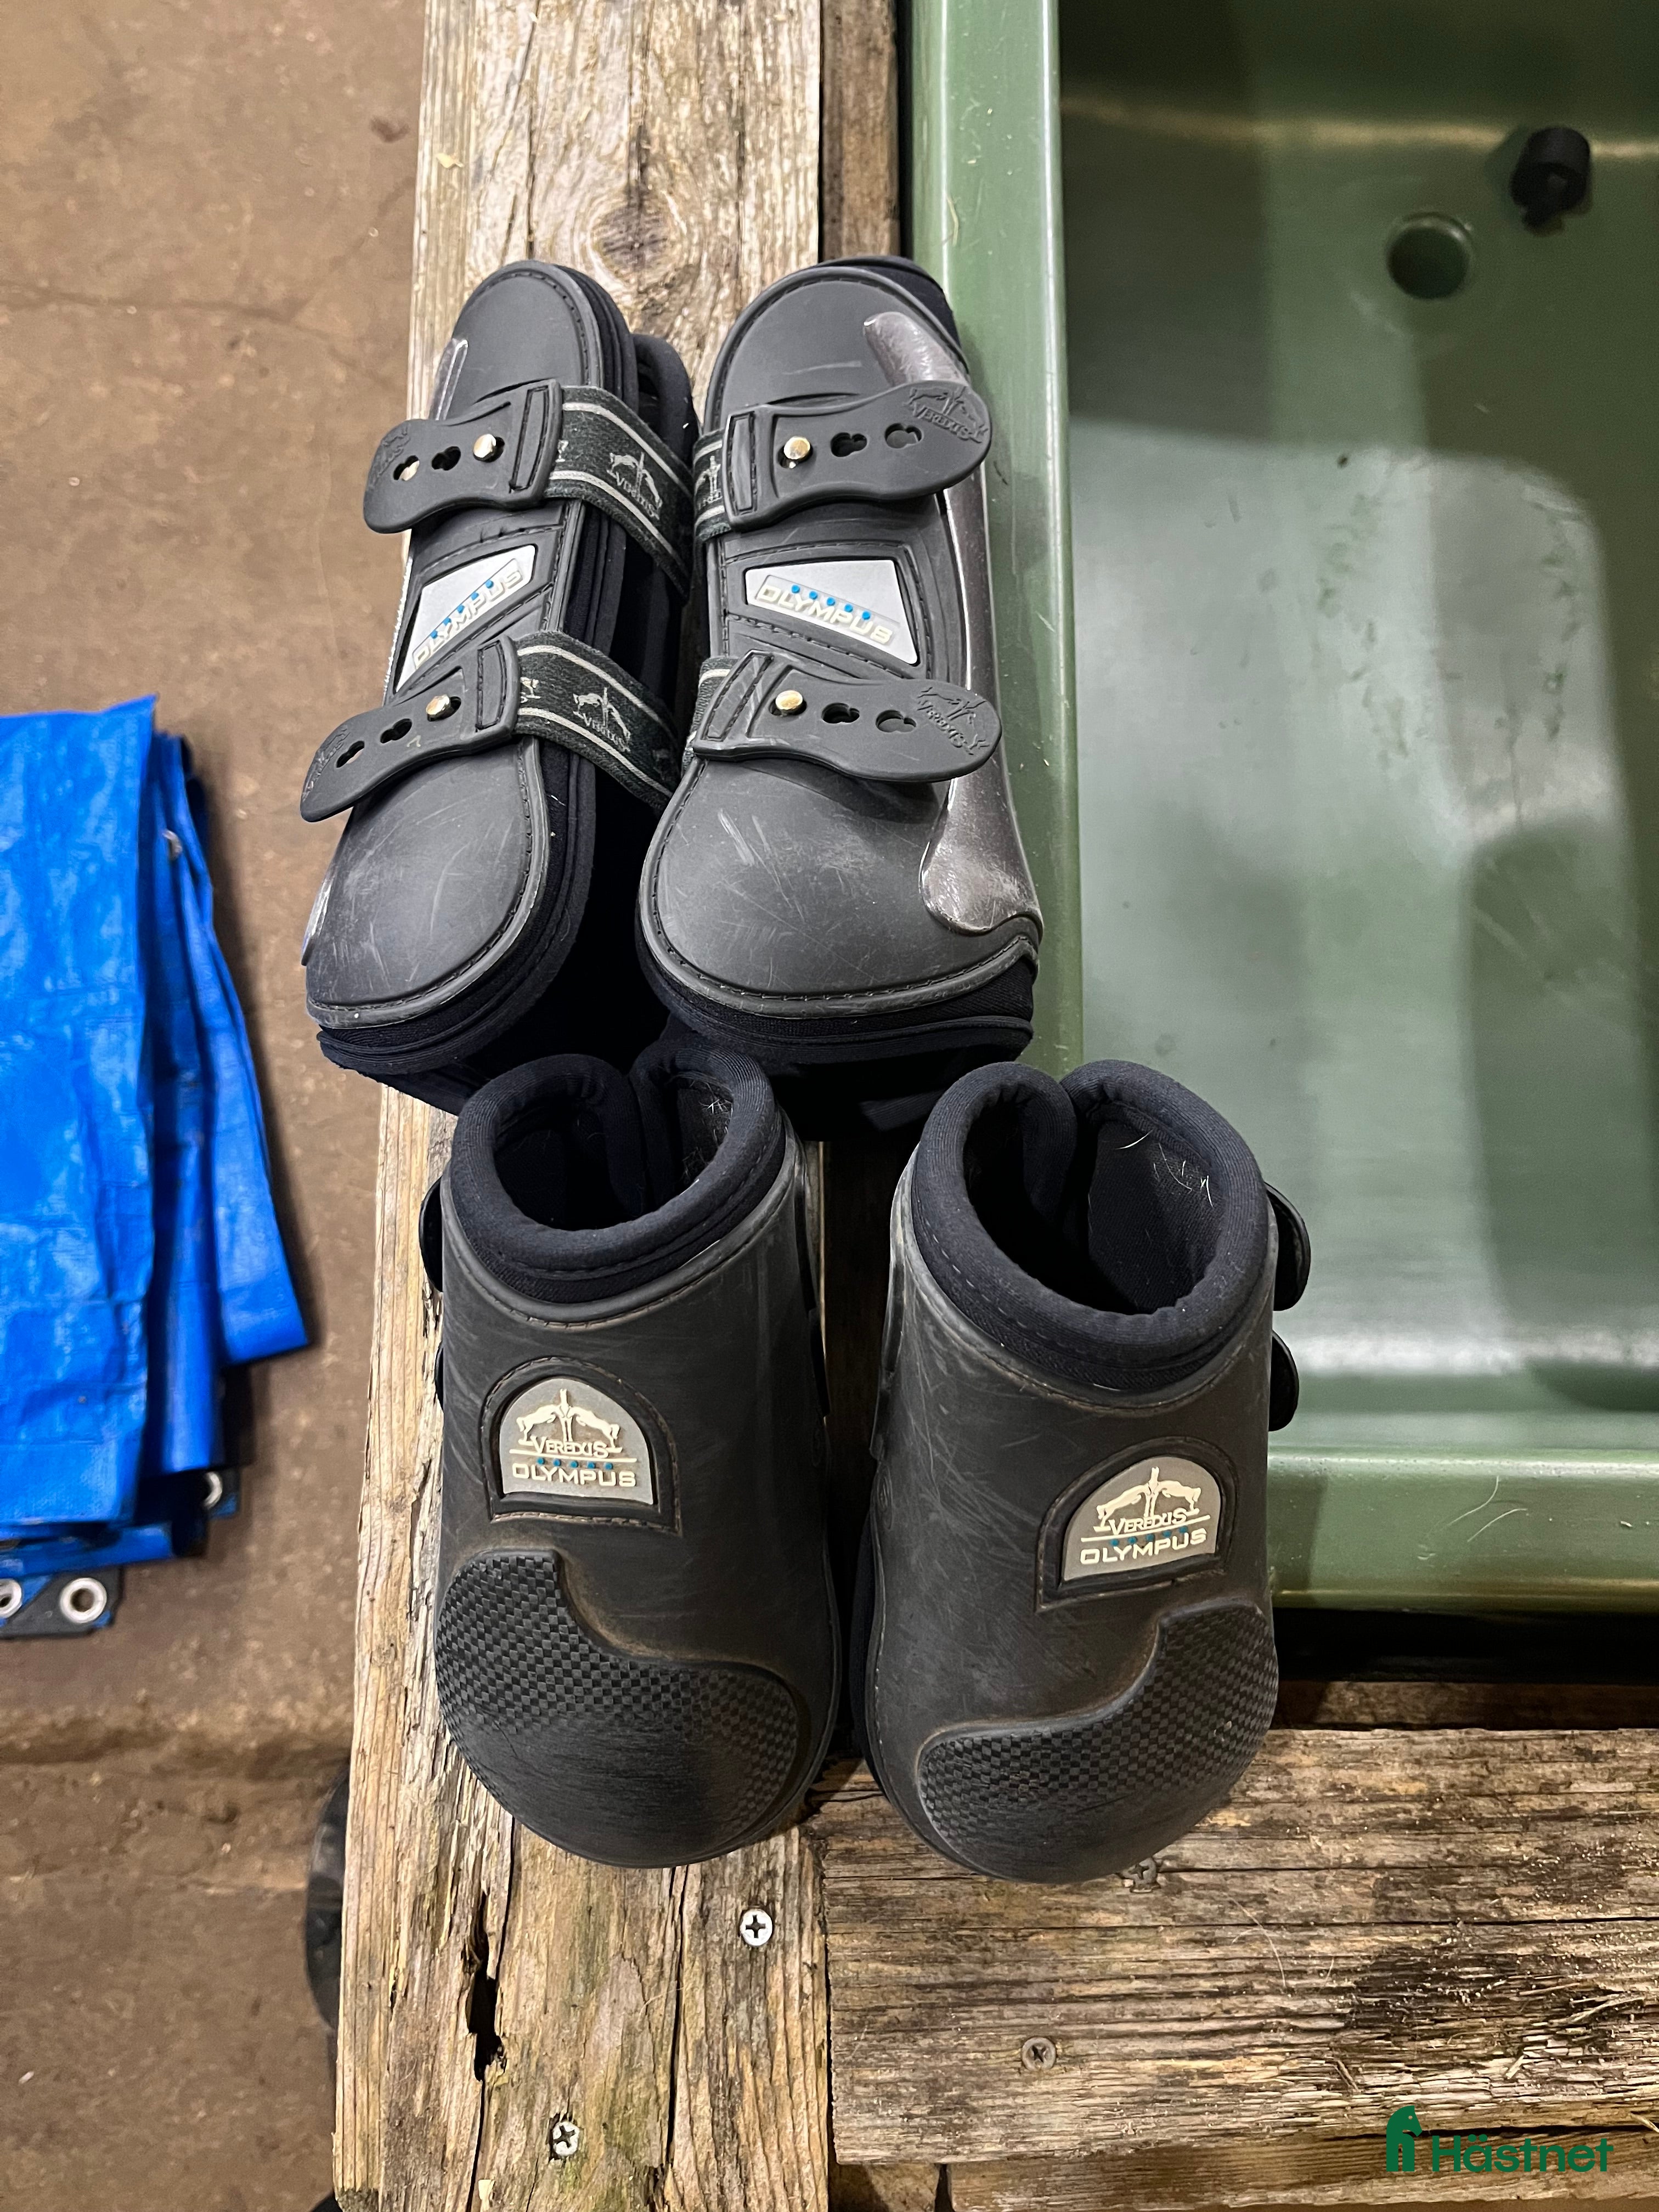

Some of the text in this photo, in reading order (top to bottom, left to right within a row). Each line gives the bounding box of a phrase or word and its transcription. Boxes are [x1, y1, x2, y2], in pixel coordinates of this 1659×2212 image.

[415, 570, 523, 669] OLYMPUS
[757, 584, 893, 644] OLYMPUS
[530, 1436, 609, 1458] VEREDUS
[512, 1463, 636, 1487] OLYMPUS
[1108, 1508, 1187, 1535] VEREDUS
[1080, 1528, 1207, 1564] OLYMPUS
